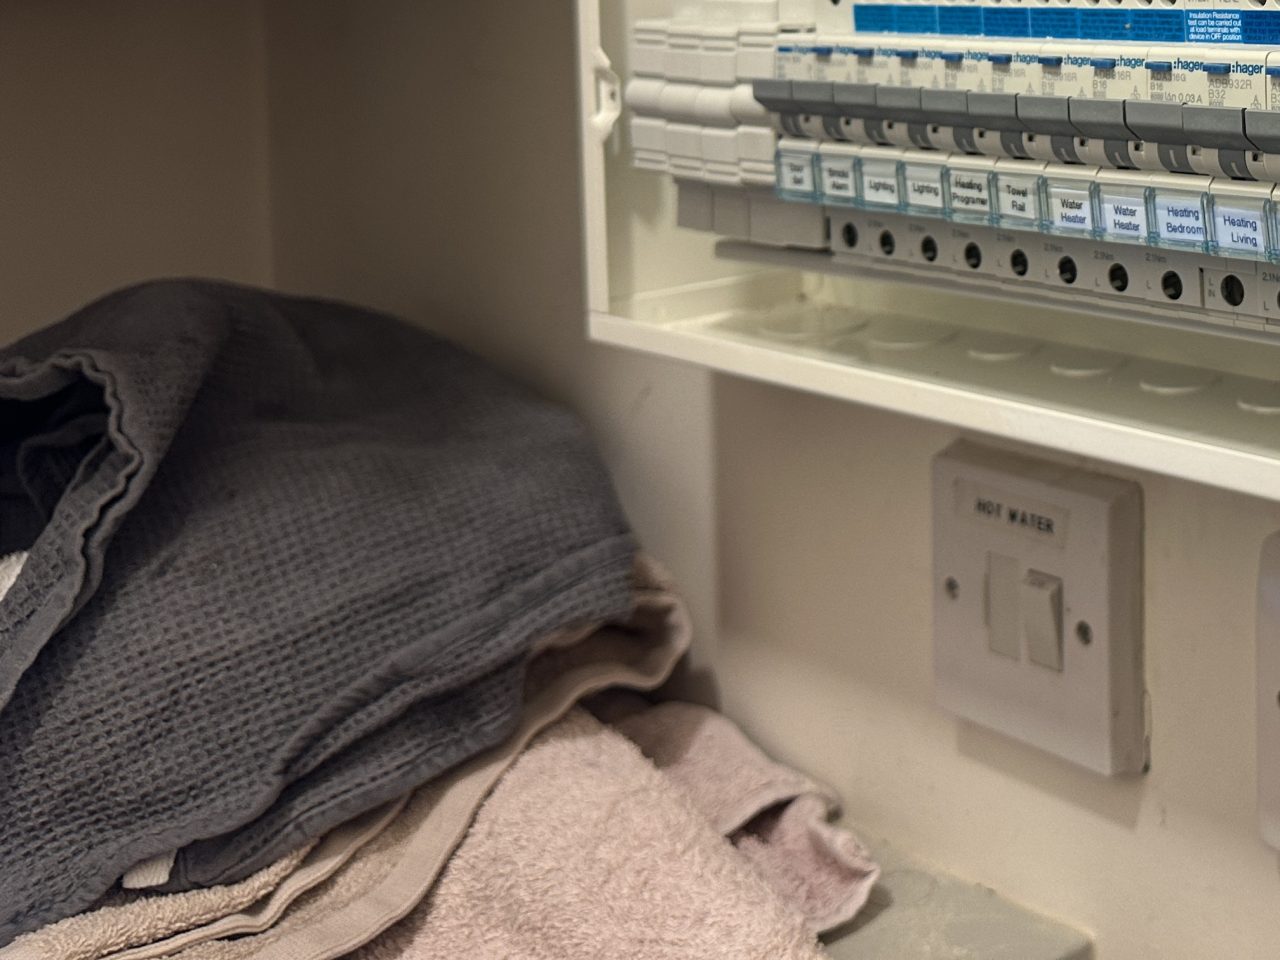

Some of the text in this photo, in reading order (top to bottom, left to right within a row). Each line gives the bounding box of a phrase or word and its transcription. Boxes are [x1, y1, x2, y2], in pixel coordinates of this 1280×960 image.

[1208, 90, 1226, 100] B32
[870, 180, 895, 194] Lighting
[913, 183, 939, 197] Lighting
[955, 176, 982, 192] Heating
[1006, 184, 1028, 198] Towel
[1012, 202, 1026, 212] Rail
[1060, 198, 1083, 210] Water
[1114, 204, 1136, 217] Water
[1061, 212, 1086, 224] Heater
[1167, 207, 1200, 221] Heating
[1114, 219, 1140, 232] Heater
[1166, 222, 1204, 235] Bedroom
[1223, 216, 1257, 232] Heating
[1231, 233, 1258, 248] Living
[976, 498, 1054, 534] HOT WATER
